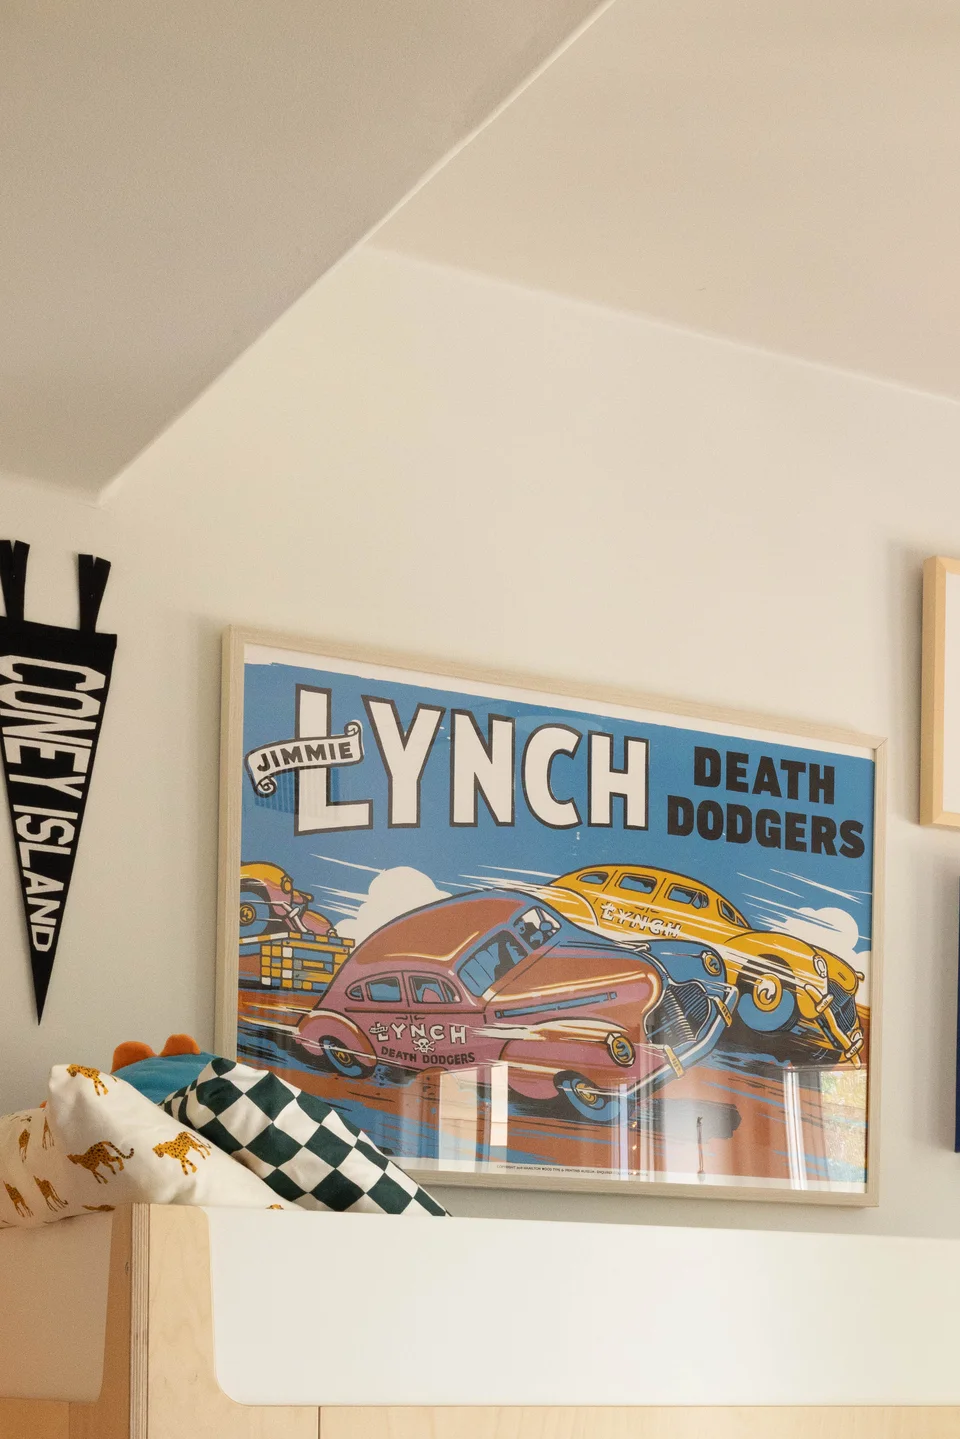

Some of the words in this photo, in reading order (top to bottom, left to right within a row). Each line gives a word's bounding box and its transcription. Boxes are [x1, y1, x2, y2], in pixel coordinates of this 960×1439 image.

[0, 654, 104, 800] CONEY
[256, 740, 352, 773] JIMMIE
[294, 684, 649, 835] LYNCH
[693, 746, 836, 805] DEATH
[667, 795, 866, 859] DODGERS
[13, 803, 78, 953] ISLAND
[601, 902, 682, 938] LYNCH
[377, 1022, 467, 1044] LYNCH
[381, 1046, 417, 1062] DEATH
[422, 1052, 476, 1065] DODGERS
